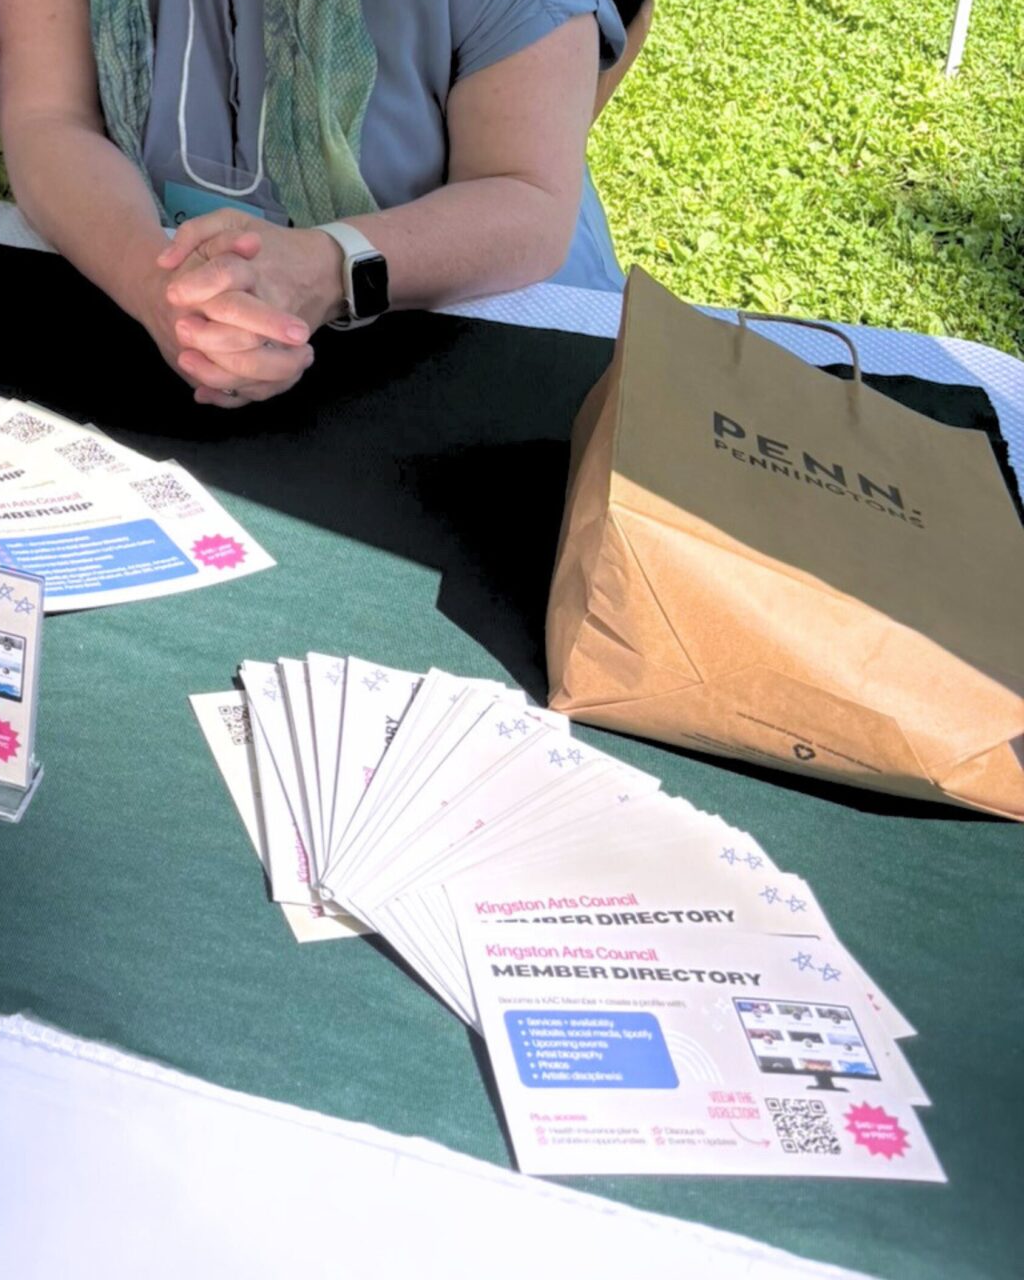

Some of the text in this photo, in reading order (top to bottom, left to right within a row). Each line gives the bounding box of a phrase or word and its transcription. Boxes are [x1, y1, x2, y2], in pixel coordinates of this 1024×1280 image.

[713, 410, 921, 515] PENN.
[714, 438, 925, 529] PENNINGTONS
[475, 893, 640, 916] Kingston Arts Council
[594, 909, 735, 926] DIRECTORY
[483, 943, 659, 961] Kingston Arts Council
[488, 962, 765, 986] MEMBER DIRECTORY
